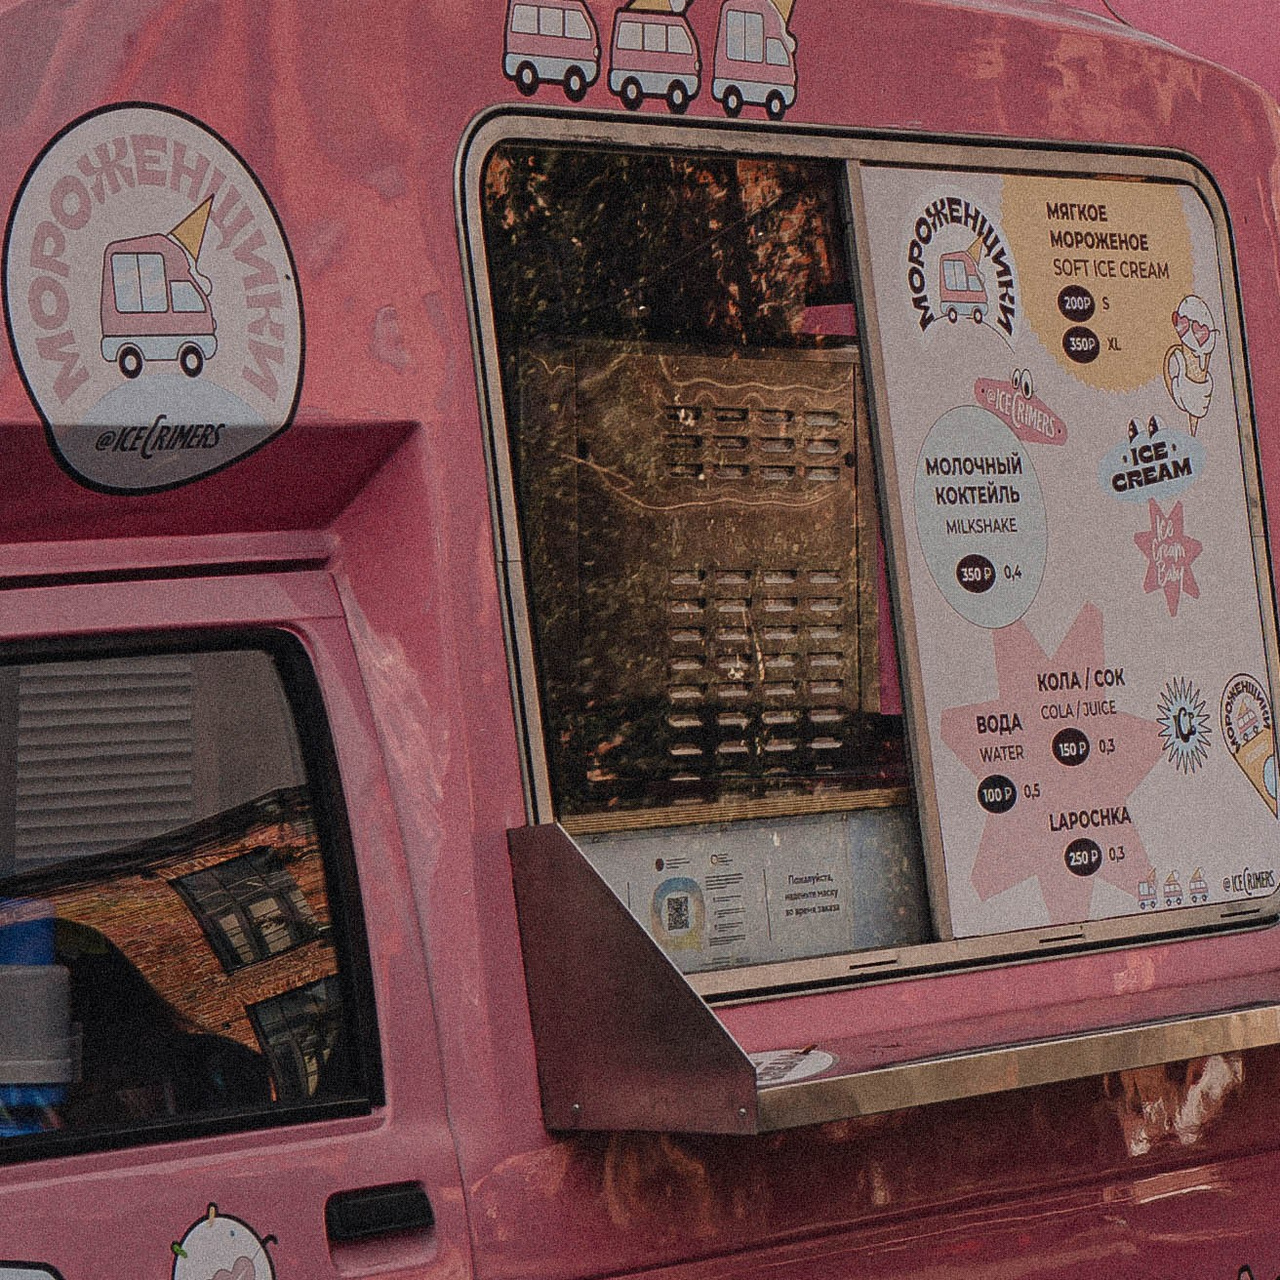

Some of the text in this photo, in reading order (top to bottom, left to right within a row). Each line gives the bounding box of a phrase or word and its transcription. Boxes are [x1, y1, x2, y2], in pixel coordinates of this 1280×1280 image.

[1046, 202, 1108, 222] МЯГКОЕ
[1049, 230, 1149, 252] МОРОЖЕНОЕ
[28, 134, 286, 404] МОРОЖЕНЩИКИ
[908, 197, 1015, 336] МОРОЖЕНЩИКИ
[1053, 258, 1170, 279] SOFT ICE CREAM
[1102, 296, 1110, 311] S
[1107, 337, 1121, 352] XL
[925, 452, 1023, 476] МОЛОЧНЫЙ
[1131, 441, 1169, 466] ICE
[1111, 458, 1193, 492] CREAM
[935, 481, 1021, 505] КОКТЕЙЛЬ
[946, 518, 1018, 534] MILKSHAKE
[1003, 564, 1022, 581] 0,4
[1037, 671, 1081, 692] КОЛА
[1094, 668, 1126, 688] СОК
[1041, 703, 1074, 720] COLA
[1083, 700, 1117, 717] JUICE
[976, 713, 1023, 735] ВОДА
[980, 744, 1025, 762] WATER
[1098, 738, 1116, 755] 0,3
[1023, 783, 1041, 800] 0,5
[1049, 806, 1132, 831] LAPOCHKA
[1108, 846, 1126, 863] 0,3
